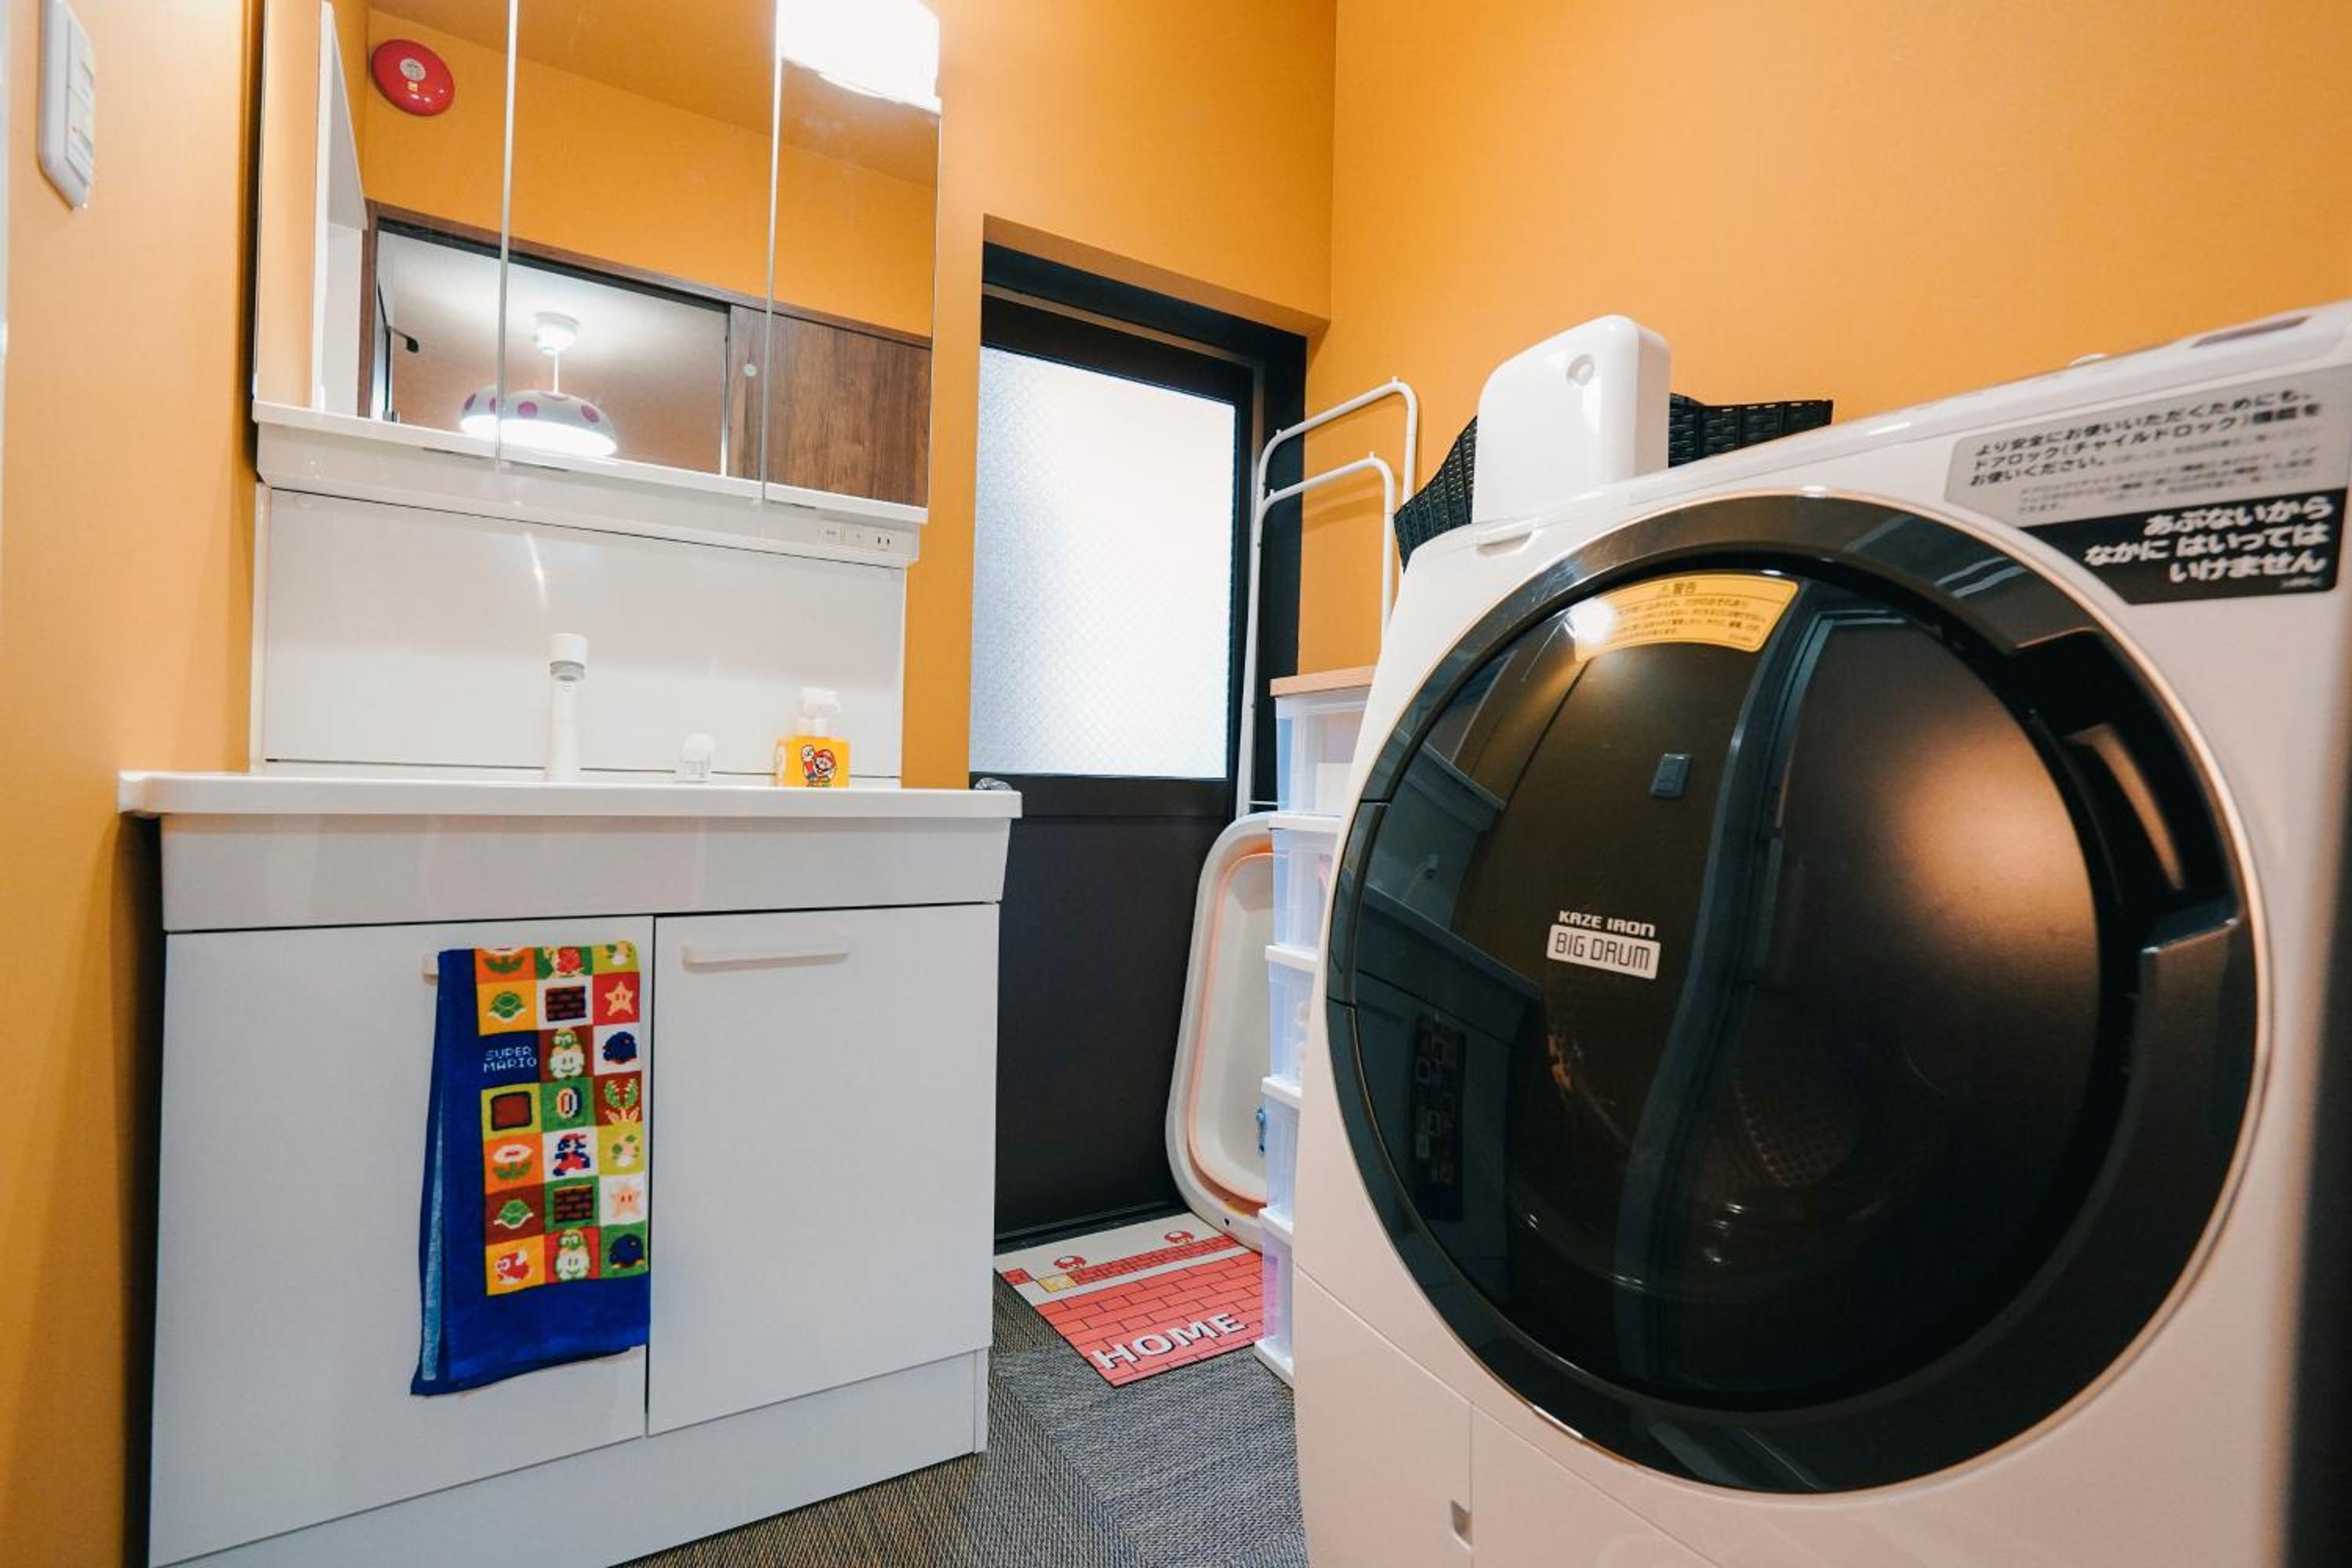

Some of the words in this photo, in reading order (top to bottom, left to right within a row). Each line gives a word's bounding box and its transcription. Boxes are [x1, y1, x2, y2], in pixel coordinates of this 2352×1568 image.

[2143, 495, 2334, 536] あぶないから
[2084, 539, 2169, 566] なかに
[2176, 522, 2330, 557] はいっては
[2169, 549, 2328, 583] いけません
[1559, 909, 1603, 929] KAZE
[1607, 916, 1656, 938] IRON
[1555, 931, 1585, 957] BIG
[1590, 938, 1651, 971] DRUM
[483, 1056, 537, 1073] MARIO
[485, 1045, 532, 1062] SUPER
[1091, 1312, 1247, 1370] HOME
